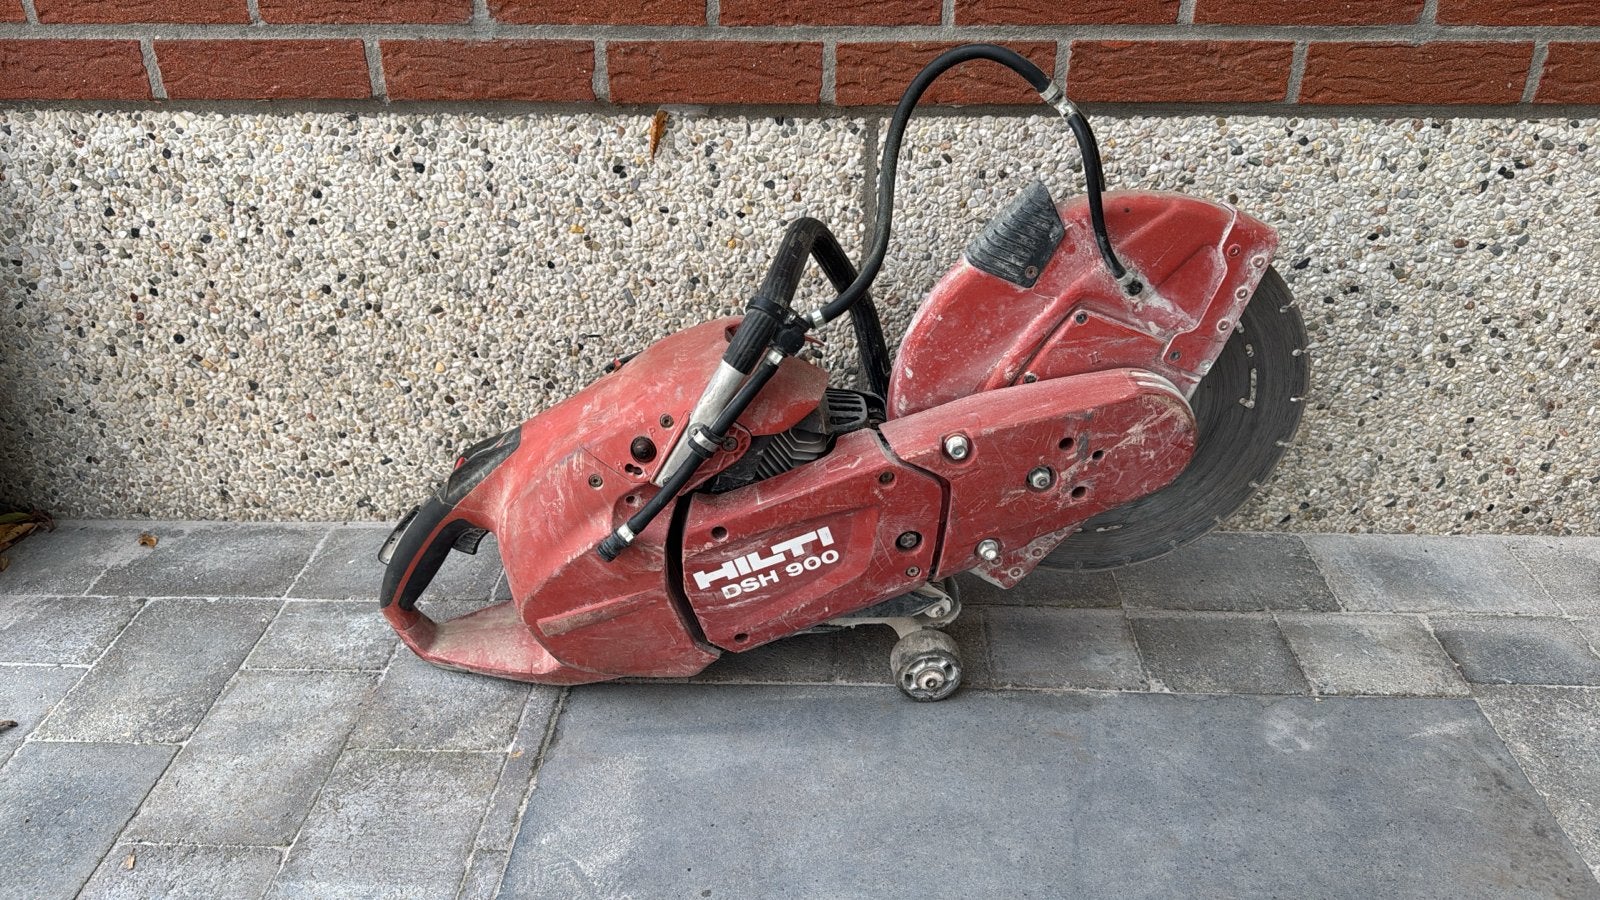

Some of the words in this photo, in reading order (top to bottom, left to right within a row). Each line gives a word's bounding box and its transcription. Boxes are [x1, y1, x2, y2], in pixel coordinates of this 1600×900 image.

[692, 526, 835, 590] HILTI
[721, 569, 780, 600] DSH
[785, 549, 840, 577] 900
